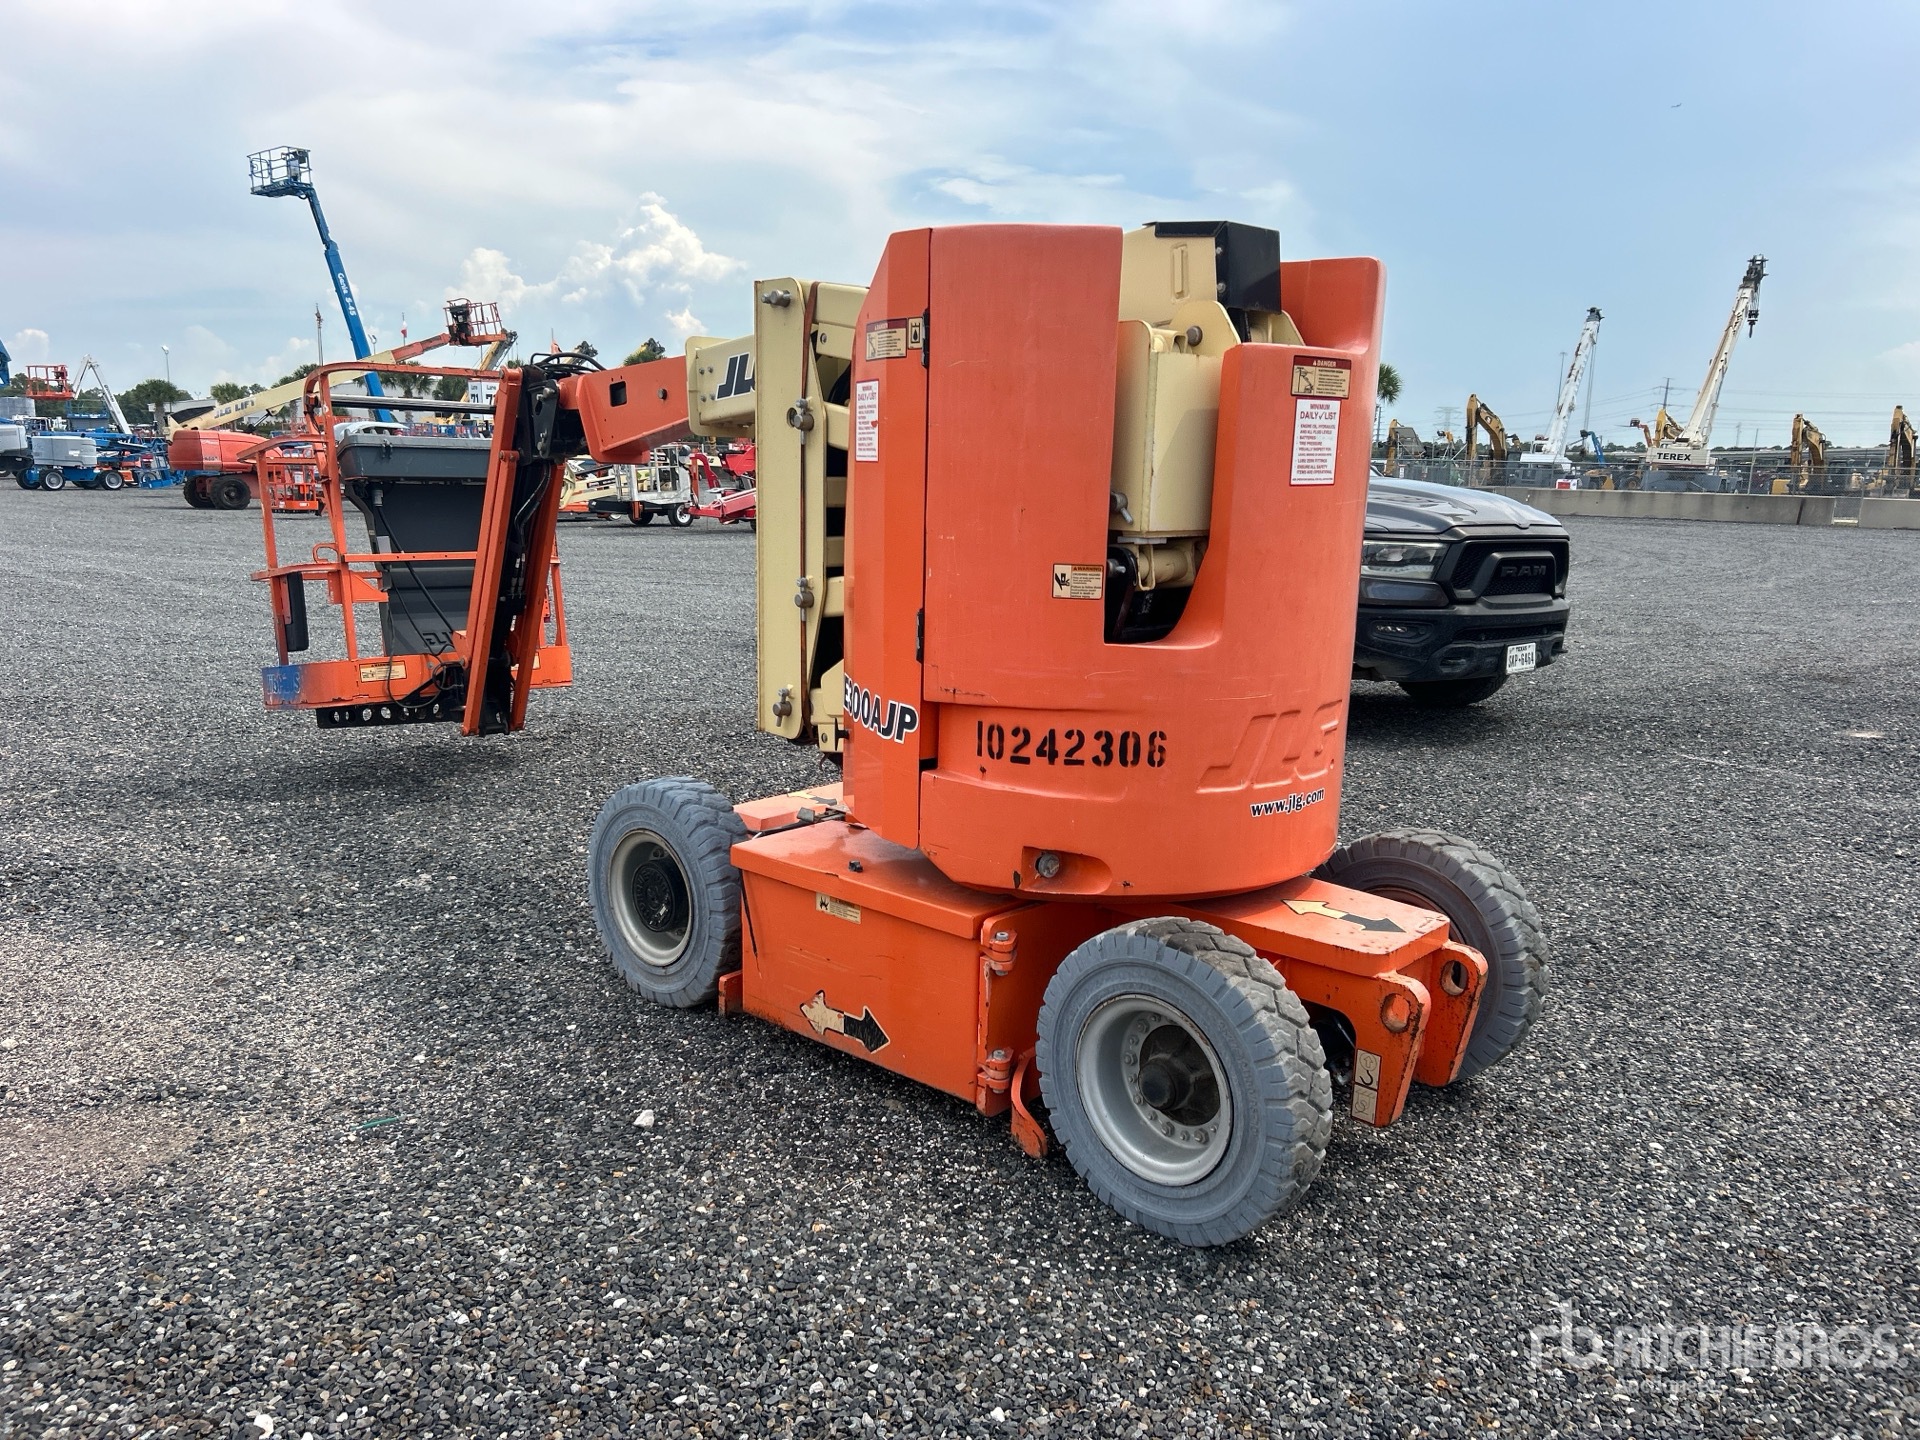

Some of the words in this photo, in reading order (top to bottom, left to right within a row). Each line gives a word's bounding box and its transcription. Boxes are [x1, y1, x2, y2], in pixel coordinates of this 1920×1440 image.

[337, 272, 349, 295] Genie
[716, 352, 756, 401] JL
[1300, 411, 1319, 420] DAILY
[1324, 412, 1337, 420] LIST
[1656, 452, 1692, 462] TEREX
[1500, 565, 1547, 578] RAM
[977, 720, 1167, 767] 10242306
[1250, 787, 1325, 817] www.jlg.com
